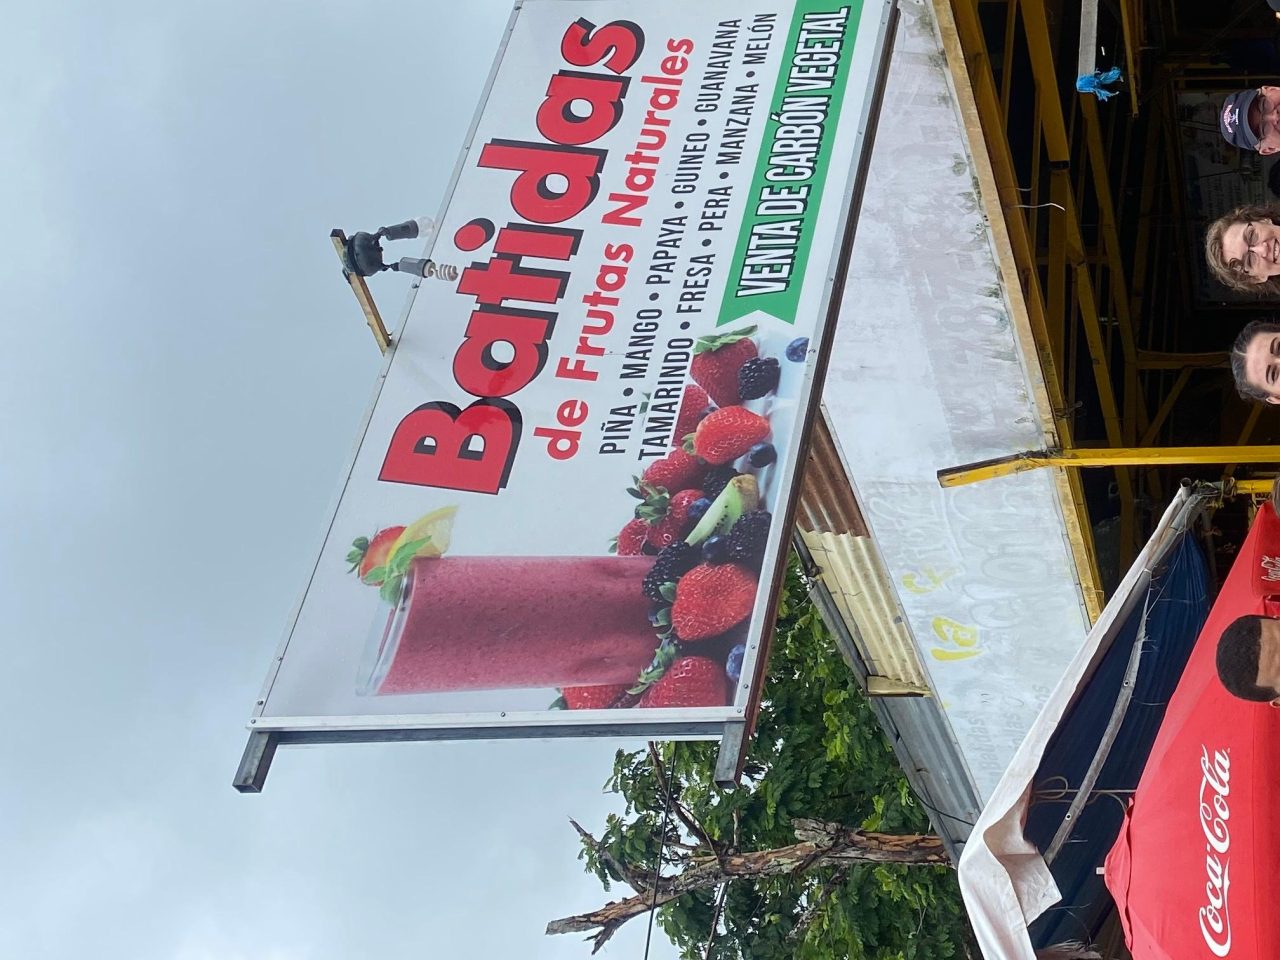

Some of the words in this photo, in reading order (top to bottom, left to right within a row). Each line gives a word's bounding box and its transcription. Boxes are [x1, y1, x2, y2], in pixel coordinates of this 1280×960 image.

[786, 6, 850, 92] VEGETAL
[602, 38, 694, 227] Naturales
[755, 184, 812, 217] DE
[765, 95, 831, 181] CARBÓN
[377, 17, 646, 495] Batidas
[599, 405, 637, 454] PIÑA
[620, 309, 662, 379] MANGO
[645, 216, 688, 285] PAPAYA
[671, 132, 710, 194] GUINEO
[694, 19, 742, 112] GUANAVANA
[638, 338, 694, 460] TAMARINDO
[676, 254, 715, 314] FRESA
[698, 186, 733, 231] PERA
[716, 84, 759, 165] MANZANA
[742, 13, 777, 64] MELÓN
[735, 218, 803, 297] VENTA
[556, 243, 634, 381] Frutas
[534, 399, 589, 460] de
[1198, 743, 1232, 958] Coca-Cola
